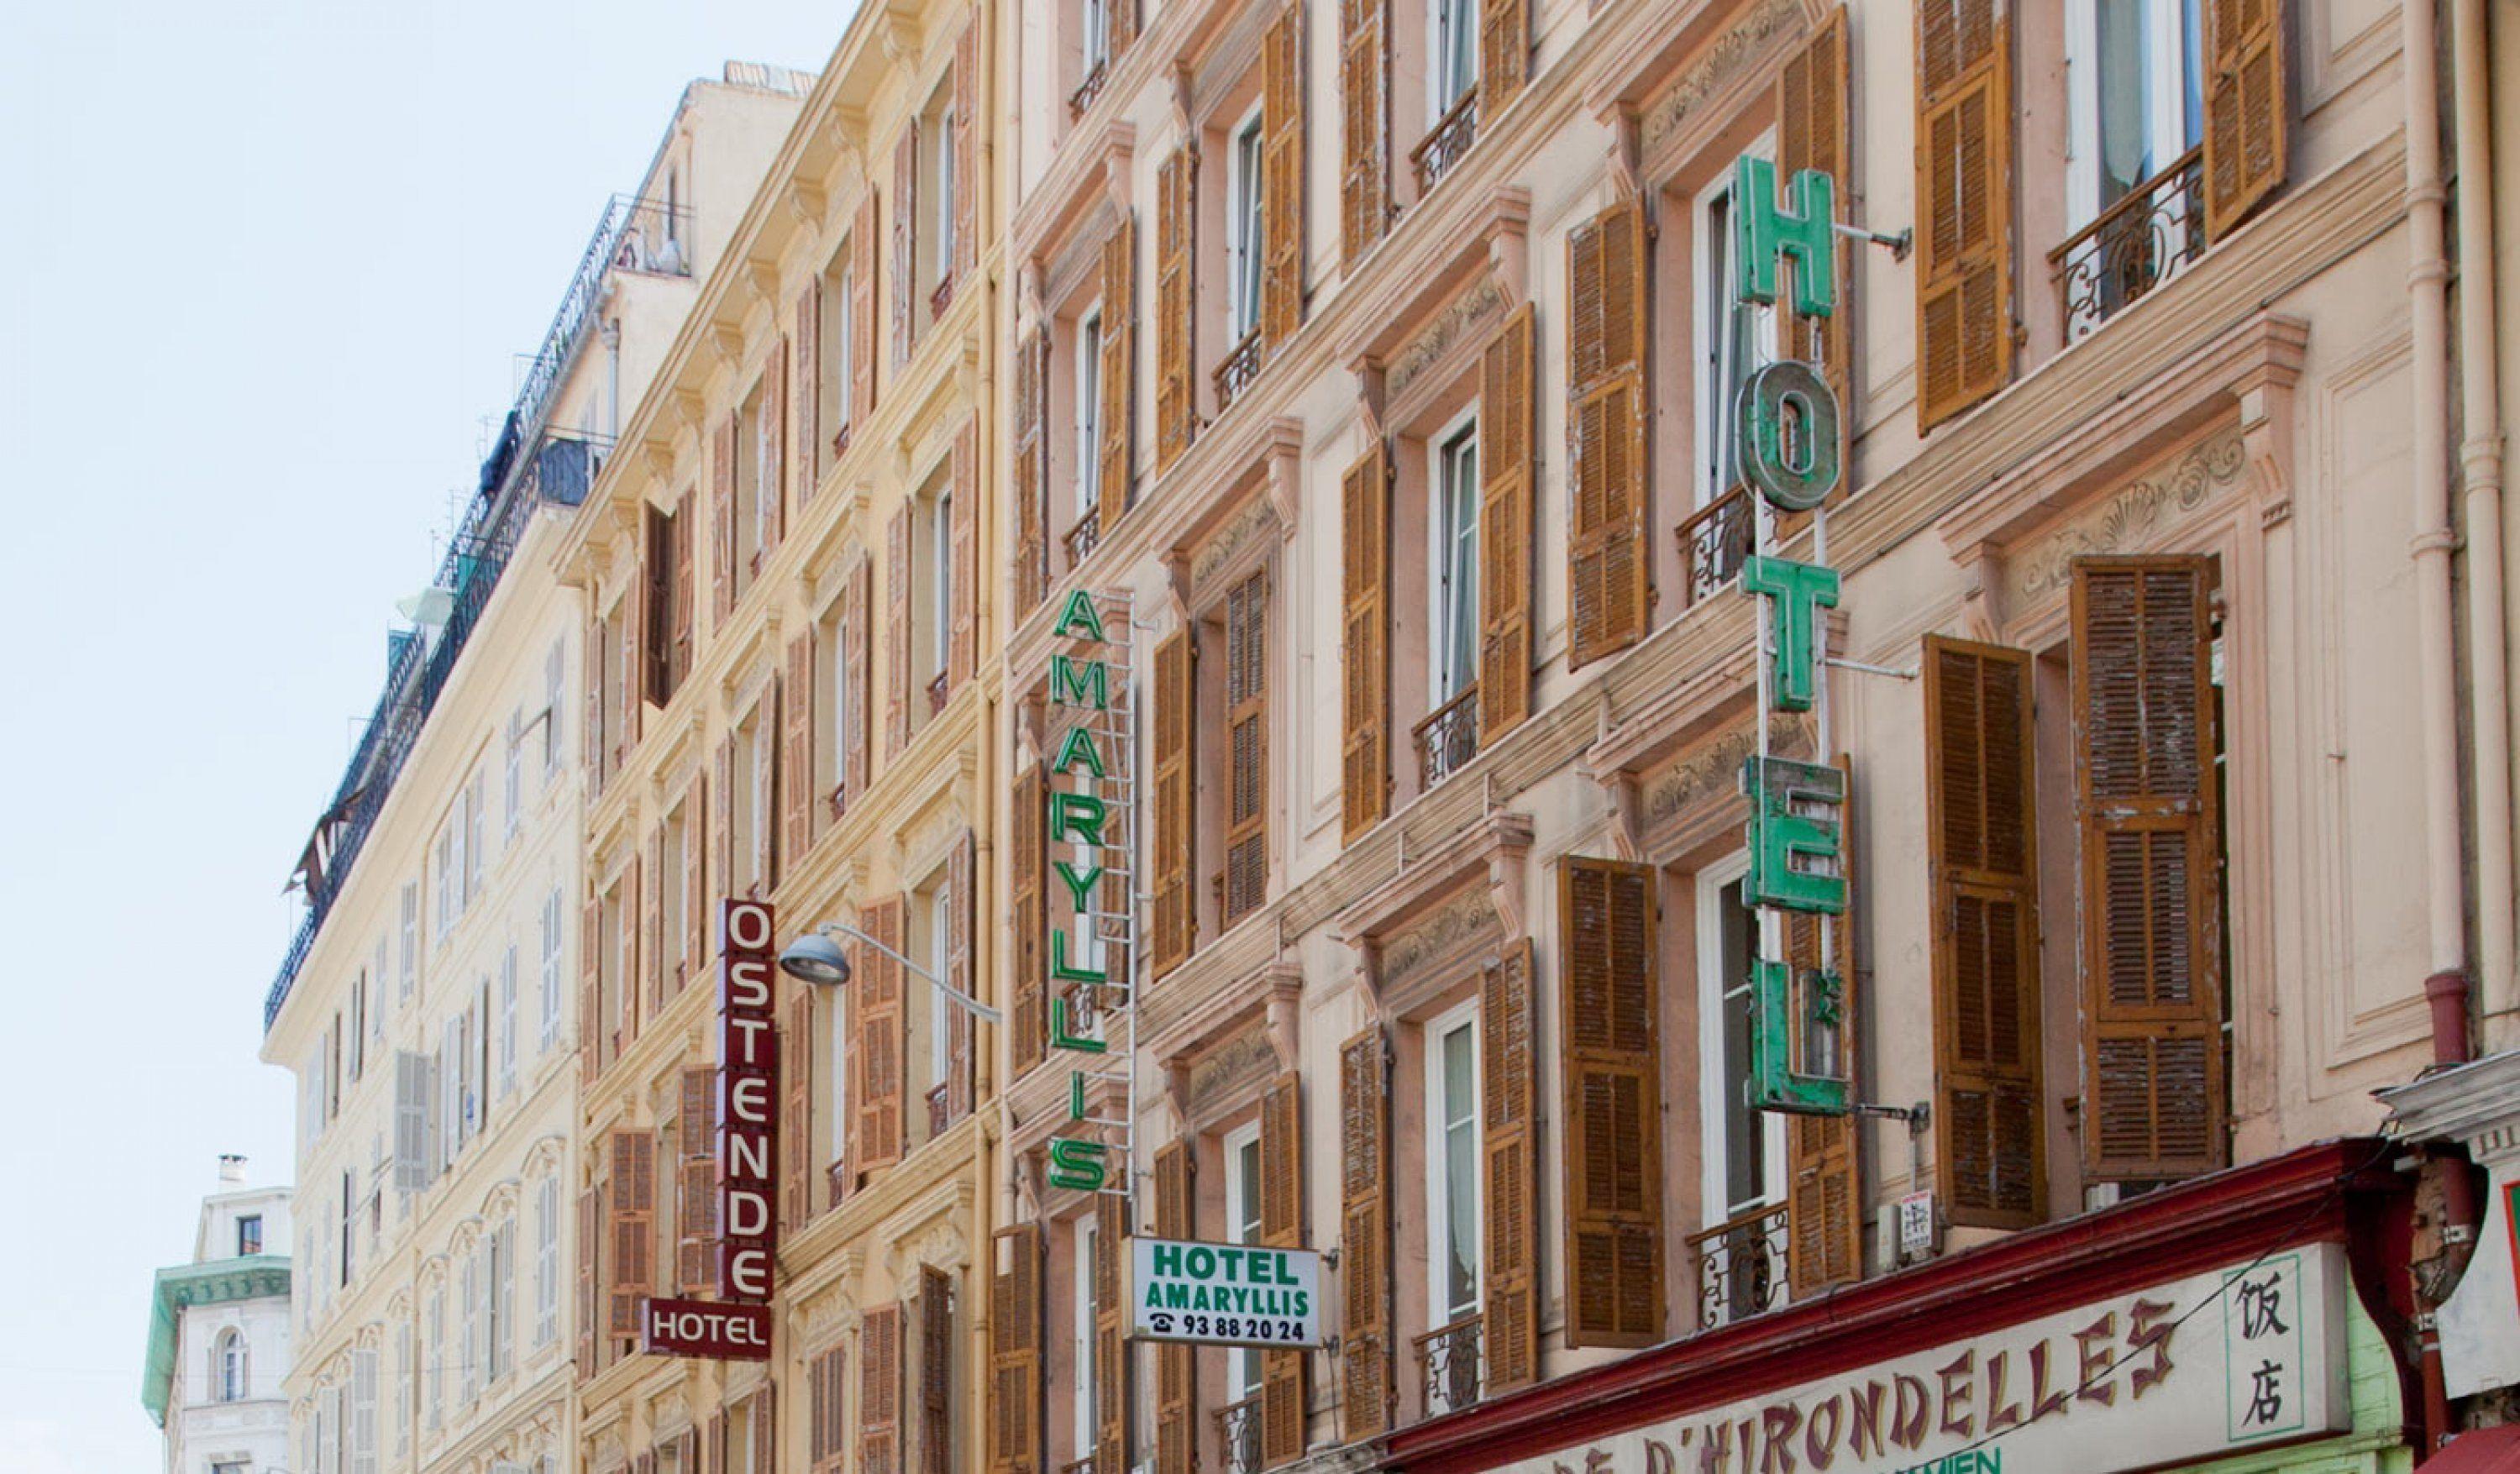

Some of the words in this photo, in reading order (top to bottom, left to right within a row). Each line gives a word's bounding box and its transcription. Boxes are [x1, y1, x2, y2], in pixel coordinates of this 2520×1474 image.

[1735, 155, 1849, 1115] HOTEL
[1050, 589, 1107, 1192] AMARYLLIS
[728, 905, 769, 1296] OSTENDE
[1146, 1281, 1310, 1317] AMARYLLIS
[1153, 1244, 1299, 1286] HOTEL
[654, 1309, 767, 1345] HOTEL
[1184, 1314, 1209, 1335] 93
[1215, 1317, 1241, 1338] 88
[1247, 1319, 1272, 1340] 20
[1278, 1320, 1304, 1341] 24
[2234, 1270, 2291, 1428] 饭店
